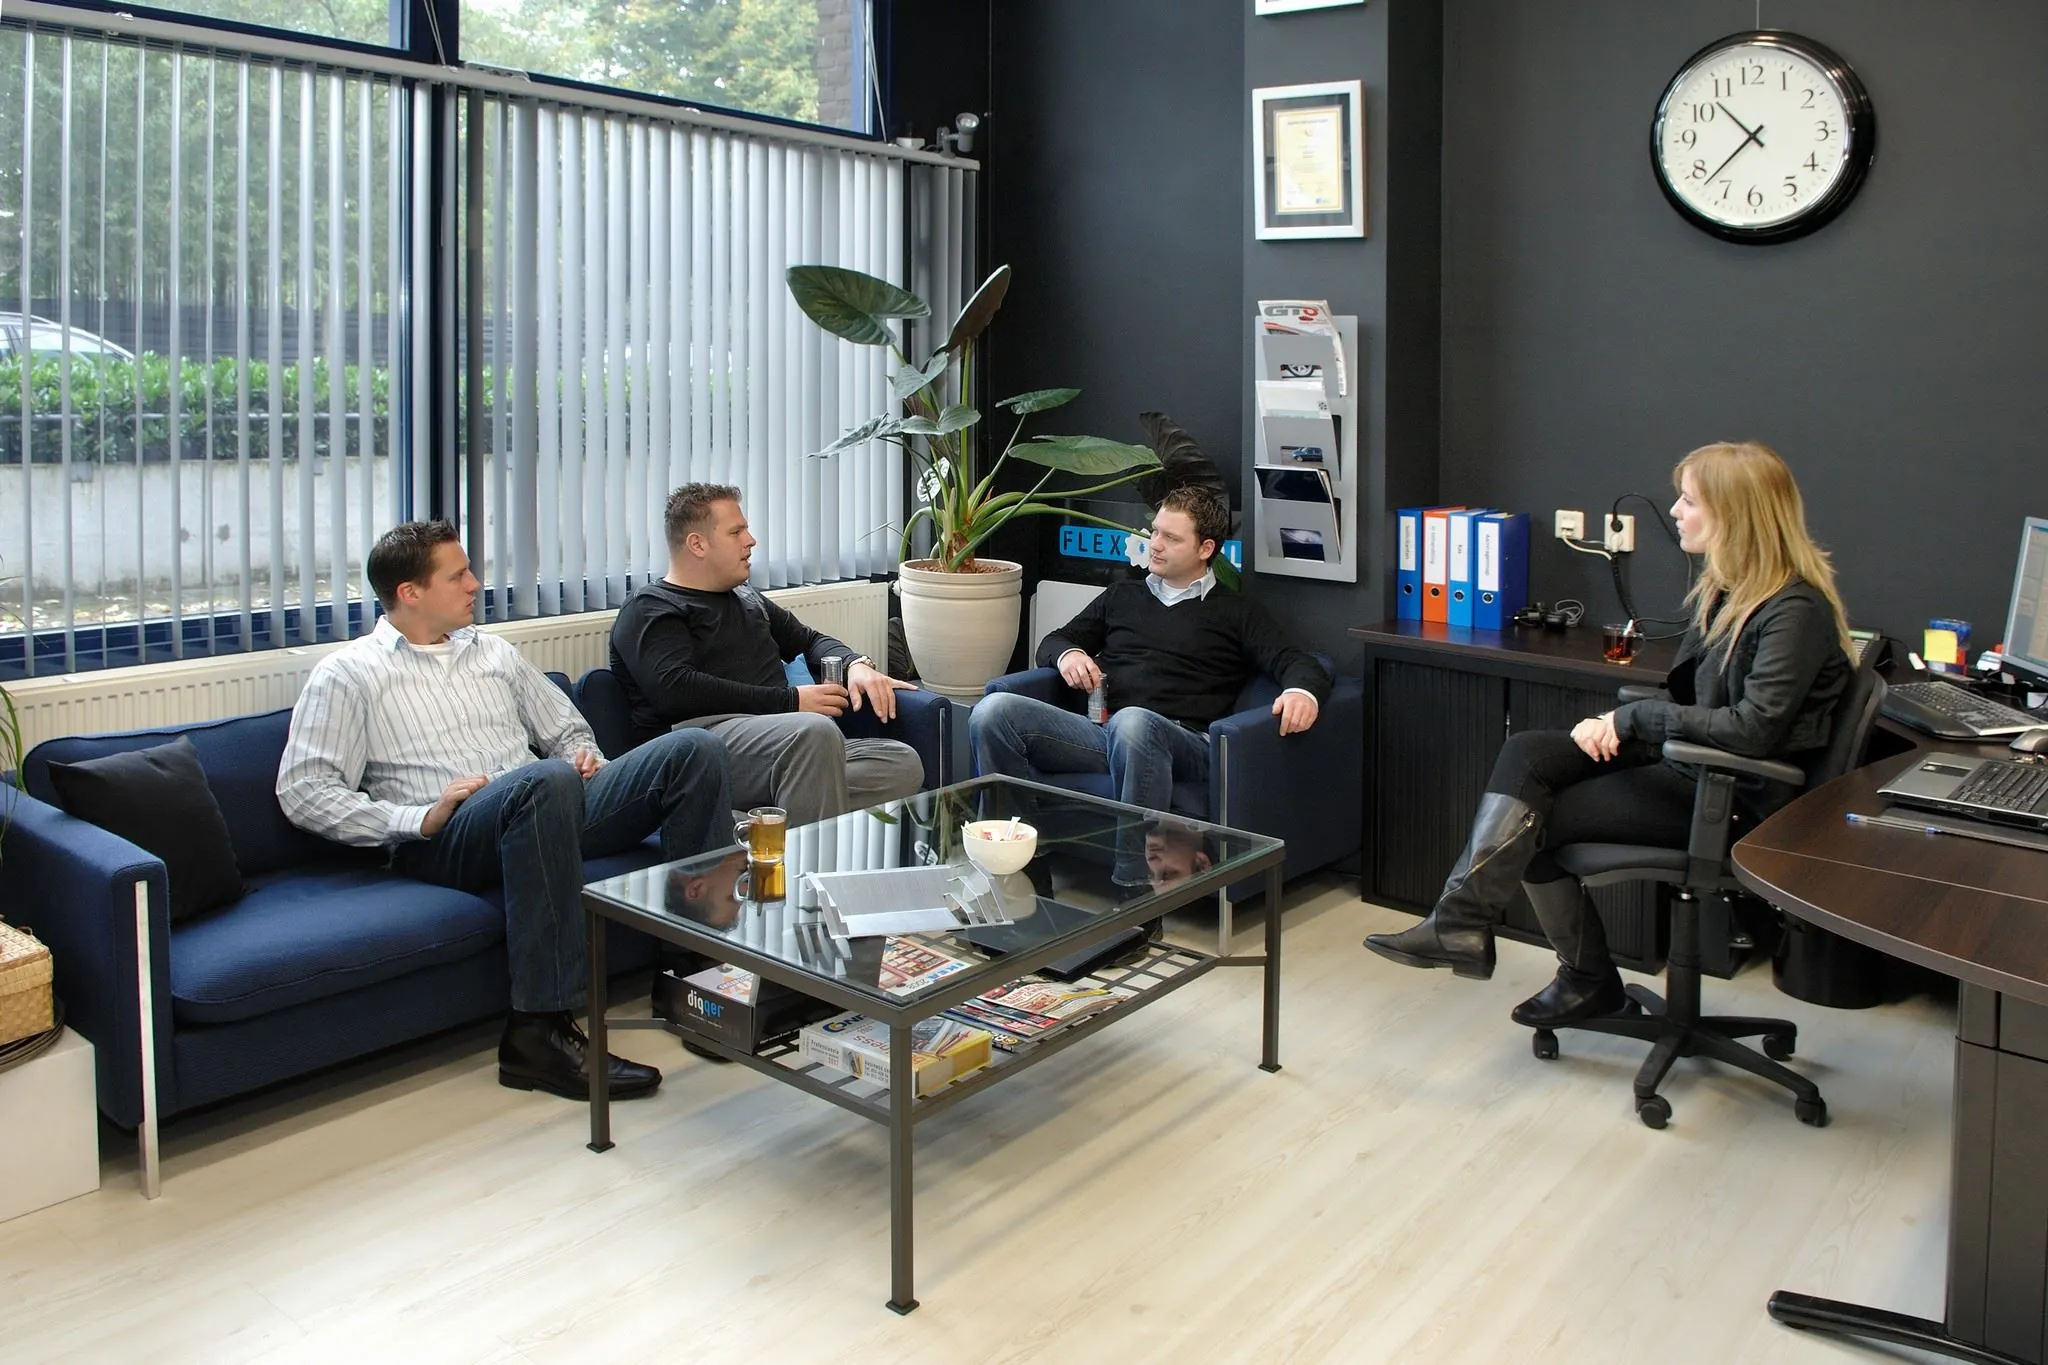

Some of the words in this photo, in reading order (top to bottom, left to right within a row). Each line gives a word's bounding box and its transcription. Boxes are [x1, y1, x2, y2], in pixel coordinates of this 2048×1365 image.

[1741, 65, 1765, 86] 12
[1780, 70, 1787, 91] 1
[1714, 77, 1733, 98] 11
[1800, 88, 1815, 109] 2
[1692, 102, 1715, 123] 10
[1681, 129, 1697, 151] 9
[1814, 121, 1829, 141] 3
[1692, 159, 1707, 180] 8
[1803, 151, 1819, 172] 4
[1719, 180, 1733, 200] 7
[1747, 184, 1763, 207] 6
[1783, 175, 1797, 197] 5
